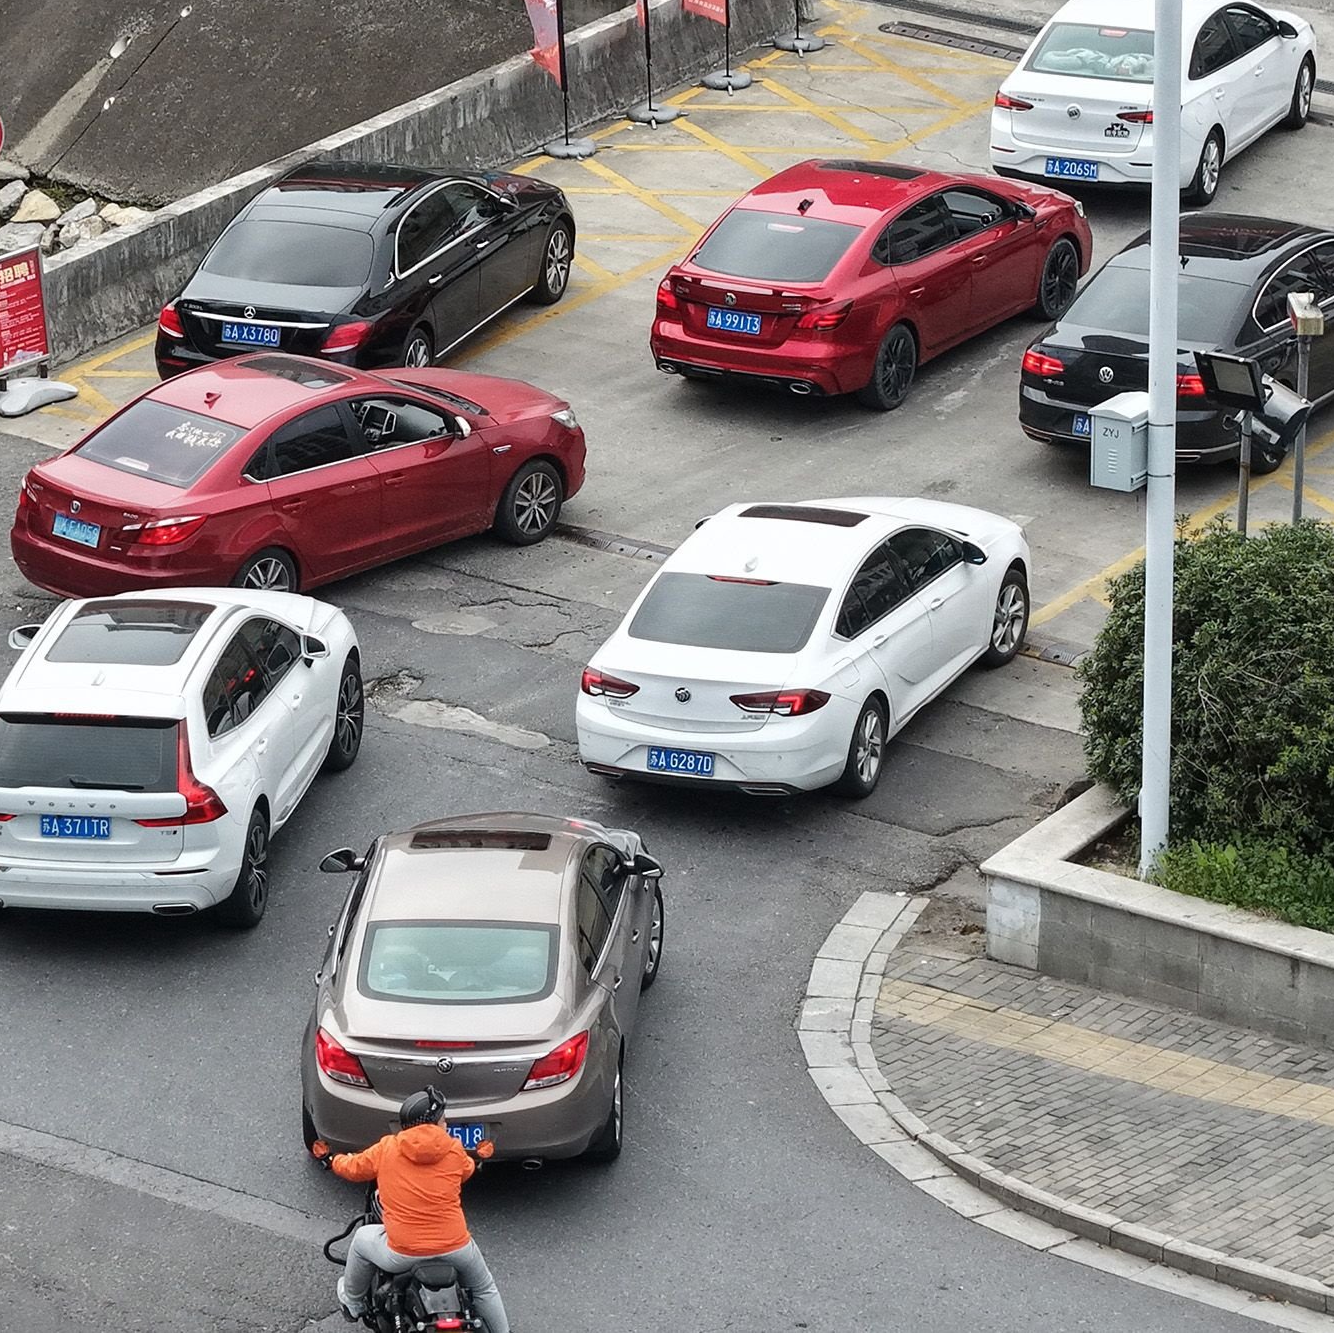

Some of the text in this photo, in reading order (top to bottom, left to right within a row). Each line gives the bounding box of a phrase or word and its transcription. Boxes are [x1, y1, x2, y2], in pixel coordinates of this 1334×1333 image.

[0, 262, 29, 285] 招聘
[1103, 426, 1119, 439] ZYJ
[28, 800, 116, 809] VOLVO
